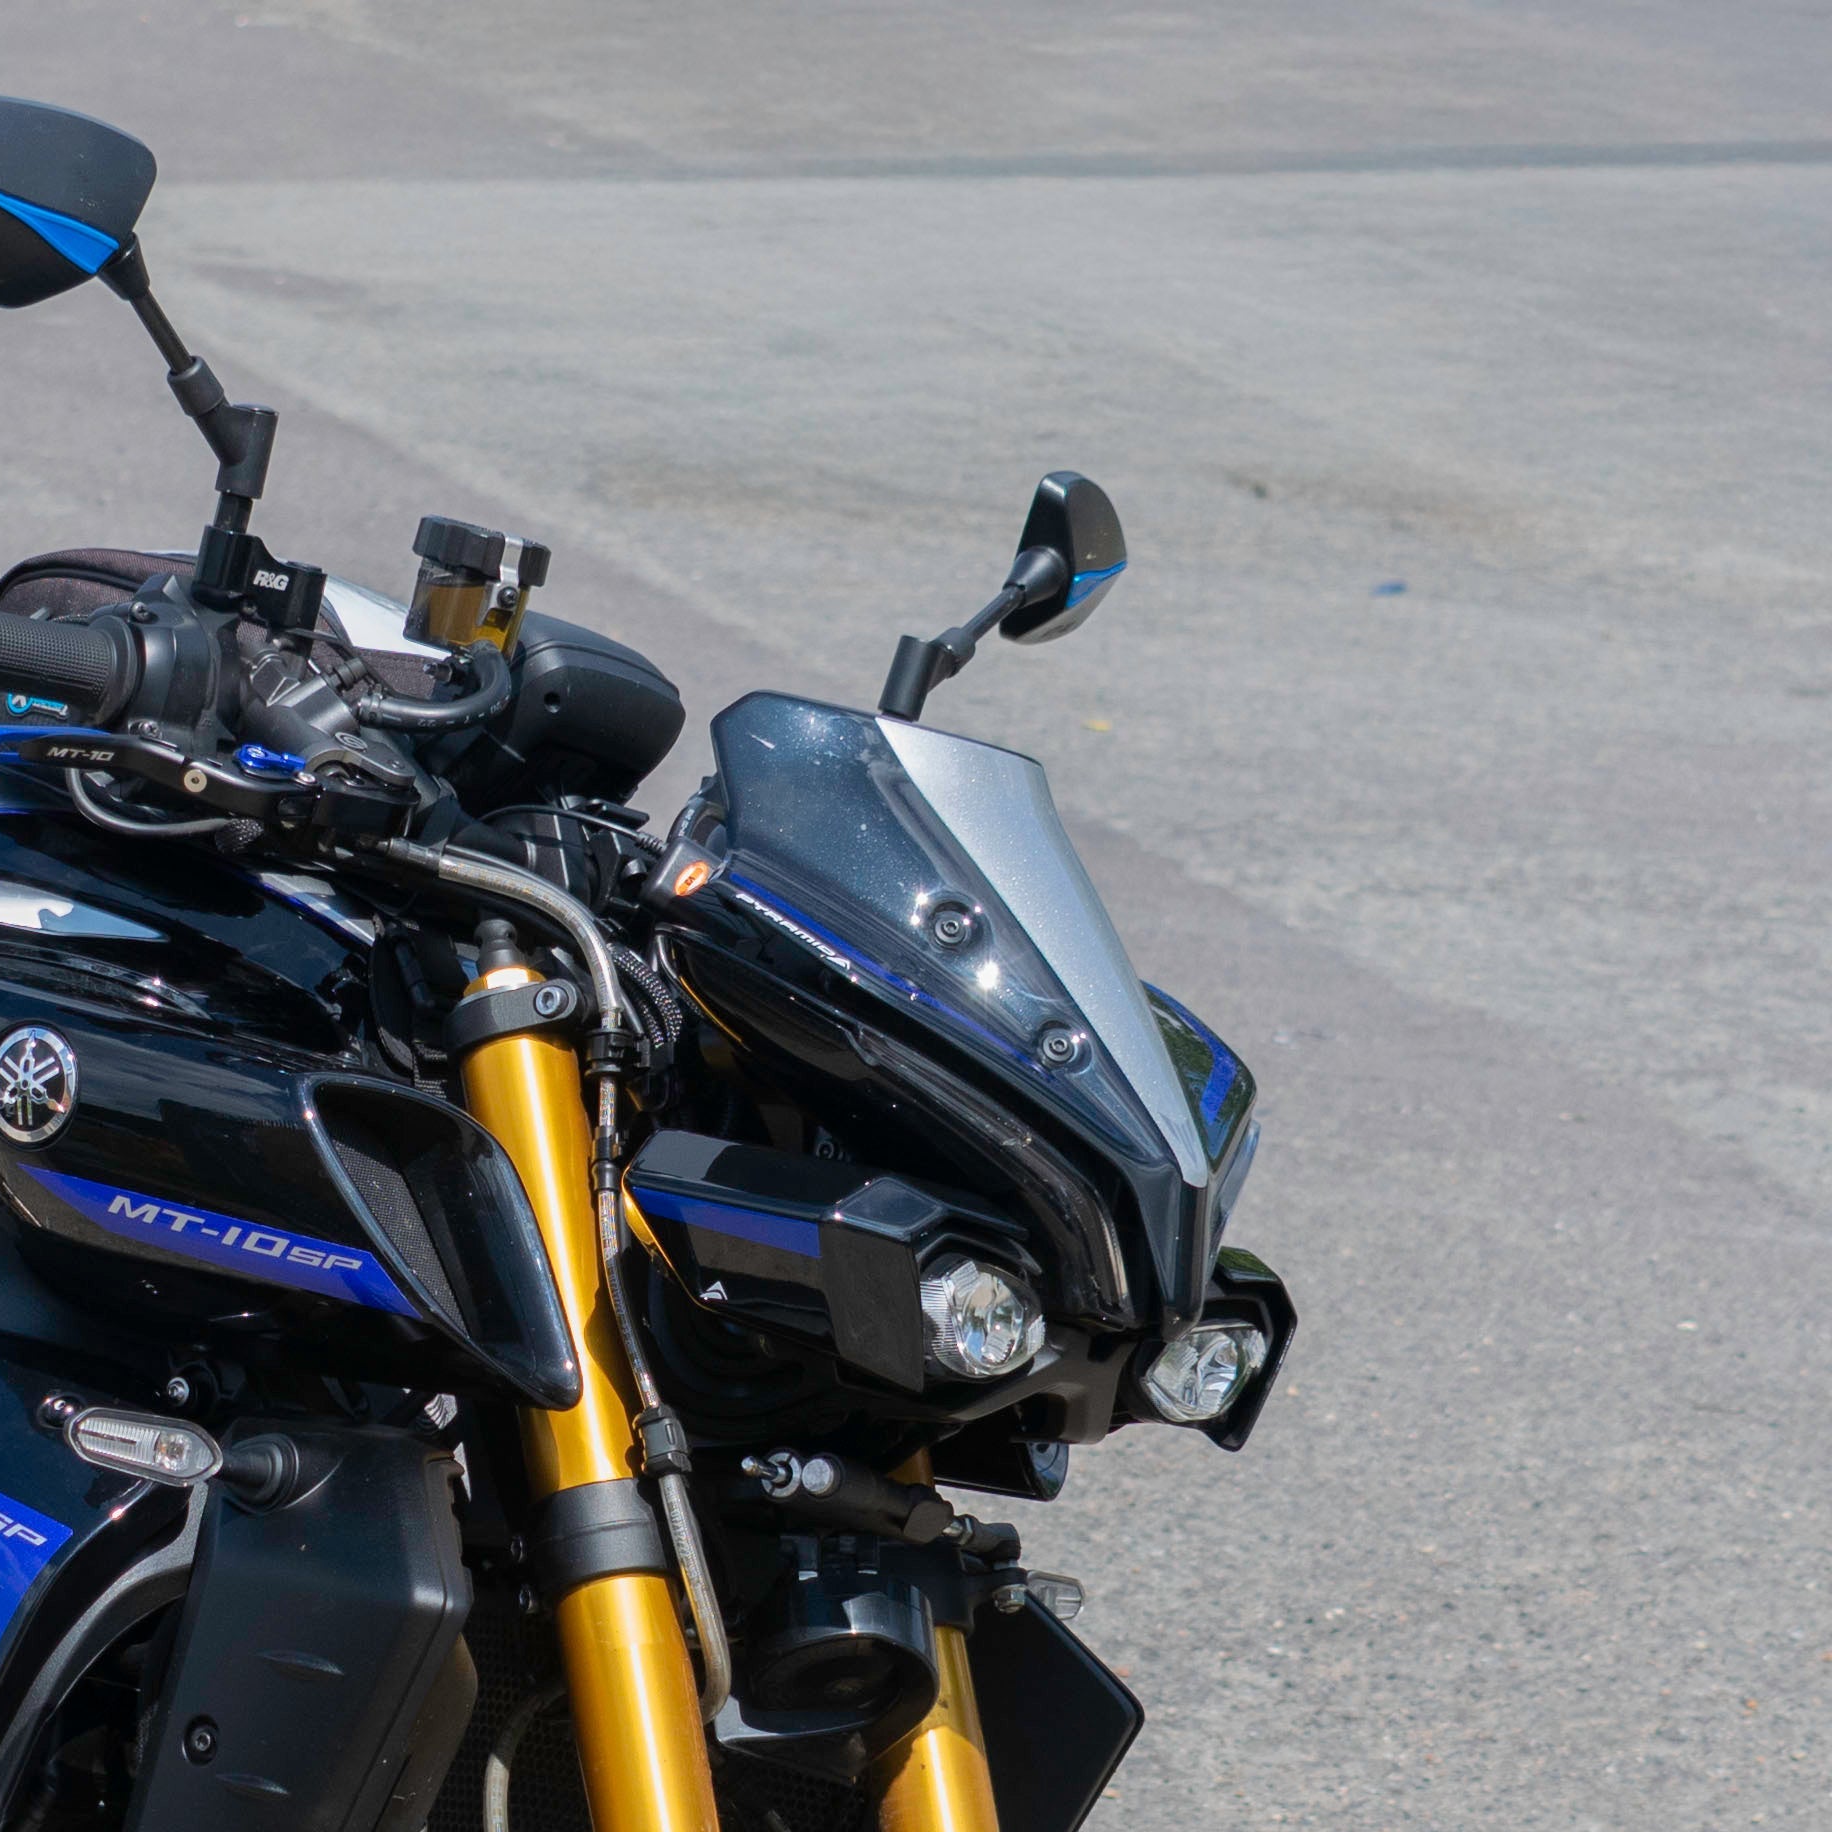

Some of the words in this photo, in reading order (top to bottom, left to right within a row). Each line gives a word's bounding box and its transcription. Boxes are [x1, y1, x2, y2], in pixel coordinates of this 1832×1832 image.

[253, 569, 290, 592] R&G
[46, 746, 116, 763] MT-10
[734, 891, 837, 958] PYRAMID
